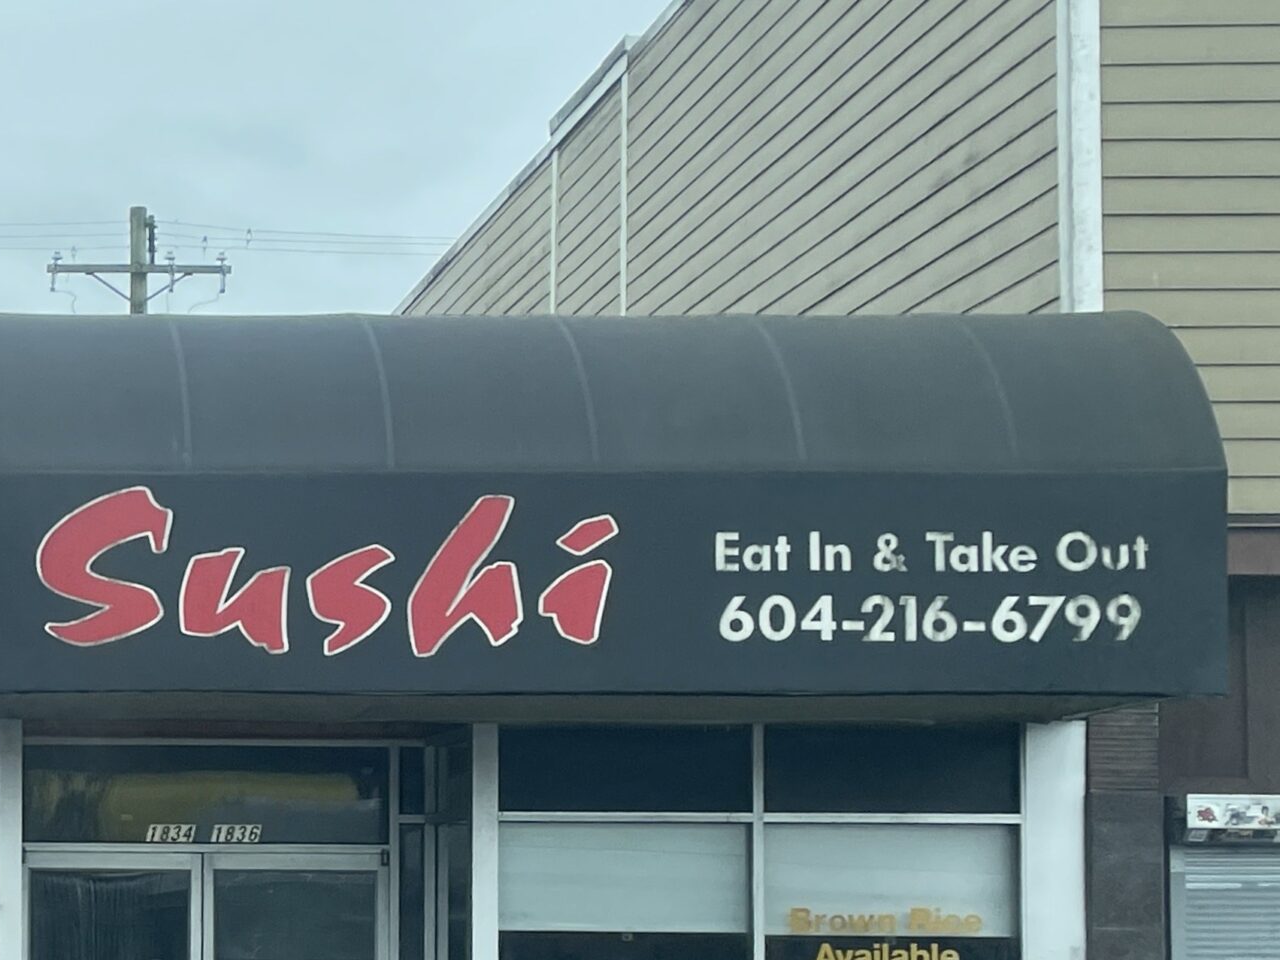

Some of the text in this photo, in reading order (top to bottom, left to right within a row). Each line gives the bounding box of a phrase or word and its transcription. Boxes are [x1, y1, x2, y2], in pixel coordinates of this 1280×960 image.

[35, 486, 620, 657] Sushi
[714, 531, 1150, 573] Eat In & Take Out
[718, 594, 1143, 644] 604-216-6799
[150, 825, 260, 842] 1834 1836
[789, 907, 983, 934] Brown Rice
